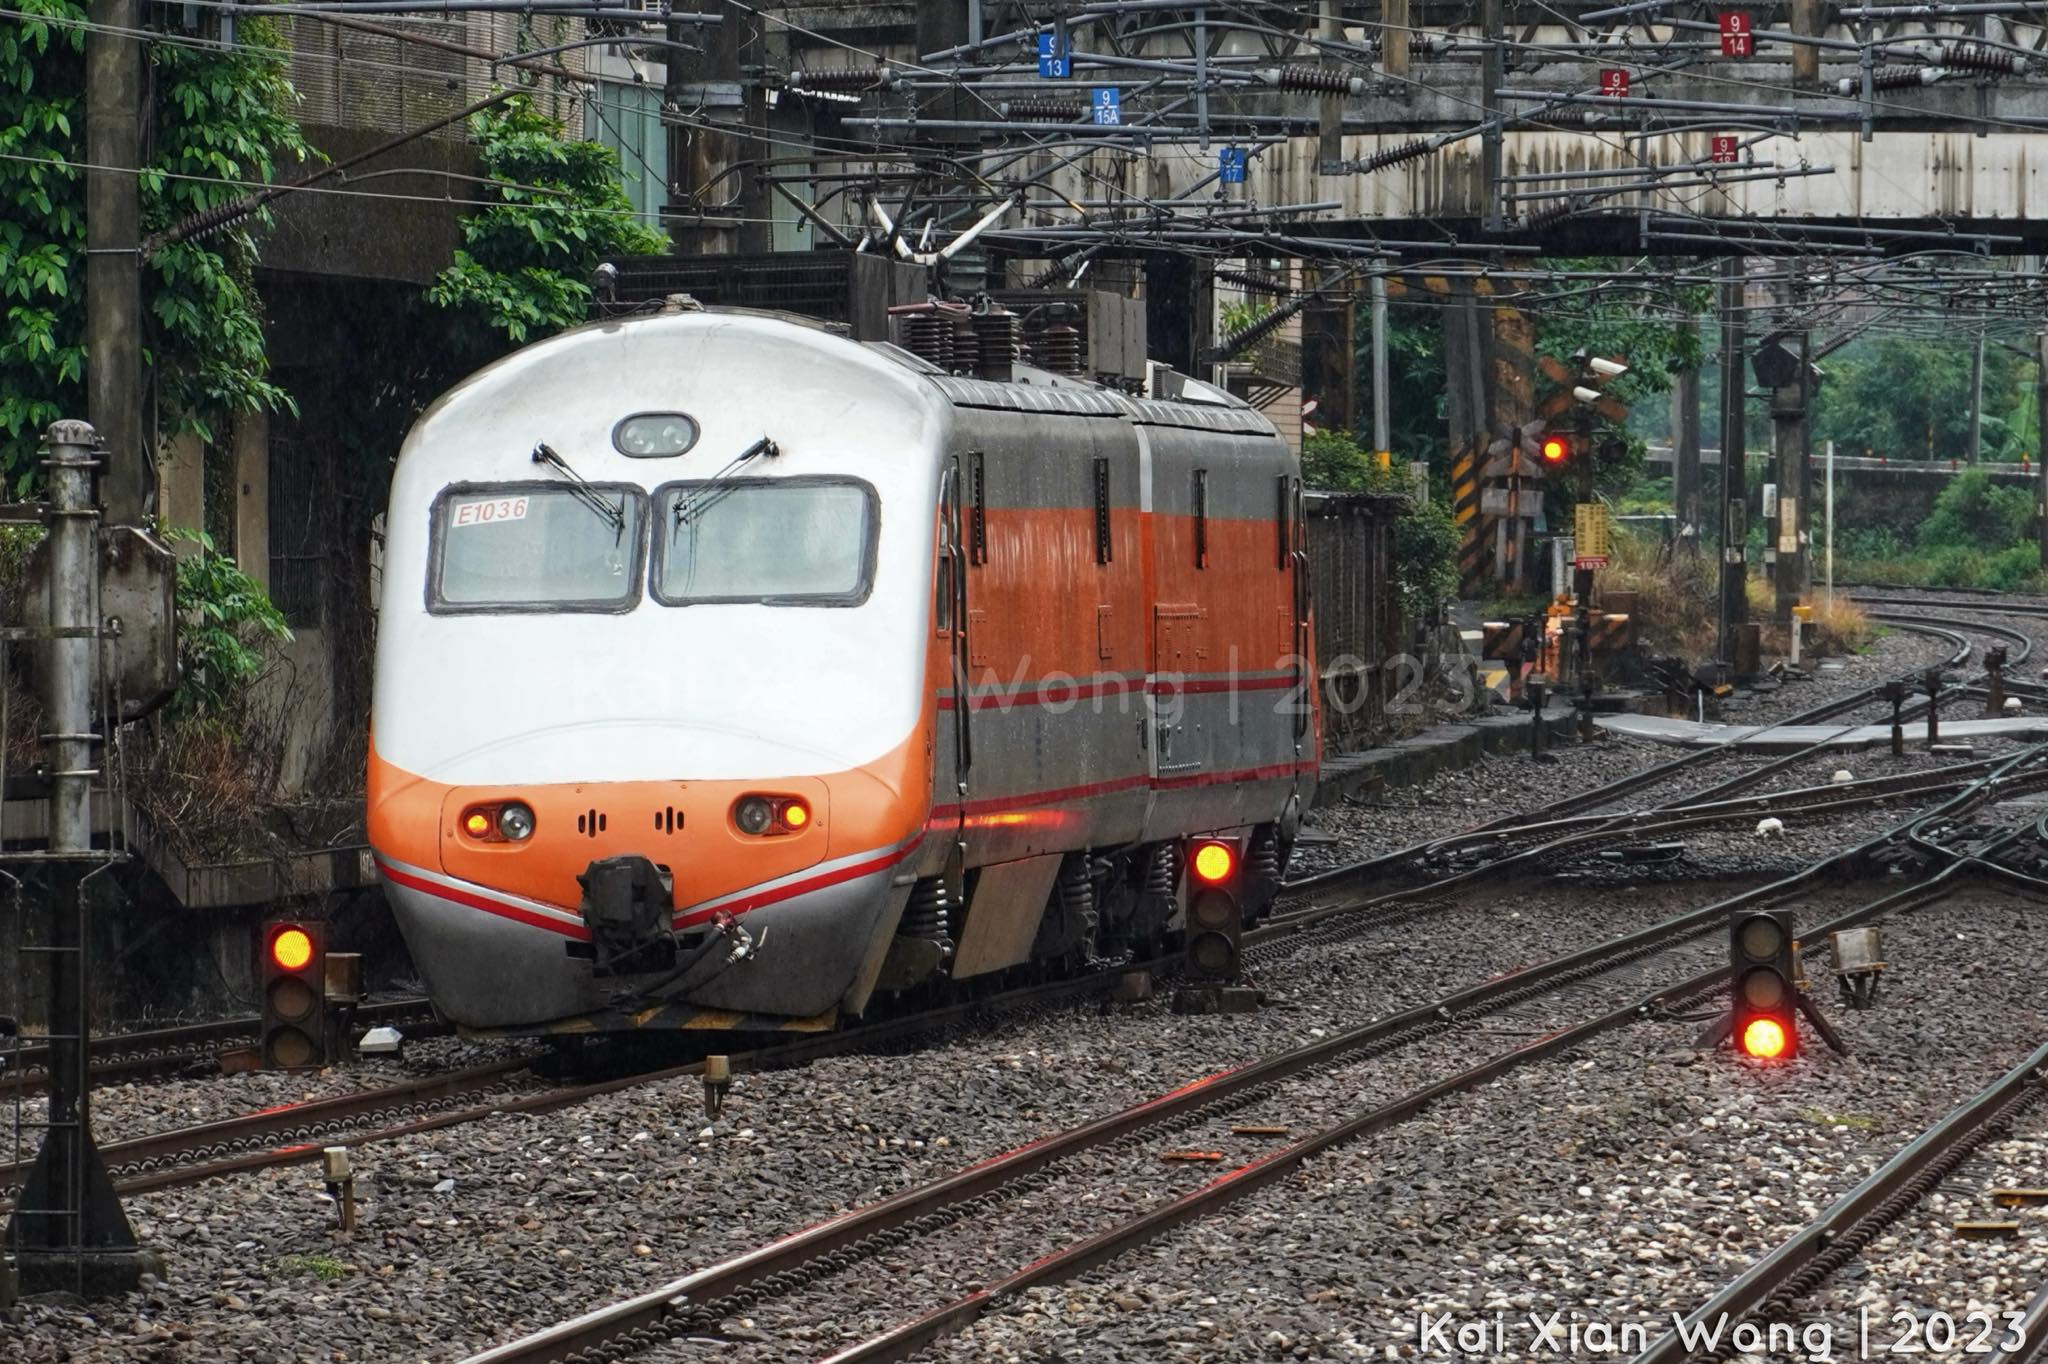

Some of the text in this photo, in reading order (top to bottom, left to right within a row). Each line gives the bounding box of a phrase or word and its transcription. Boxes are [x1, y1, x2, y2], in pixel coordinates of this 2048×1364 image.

[1730, 15, 1740, 33] 9
[1729, 37, 1745, 55] 14
[1047, 60, 1063, 76] 13
[1612, 72, 1621, 87] 9
[1102, 90, 1111, 105] 9
[1096, 109, 1119, 125] 15A
[1720, 138, 1728, 153] 9
[457, 499, 527, 525] E1036
